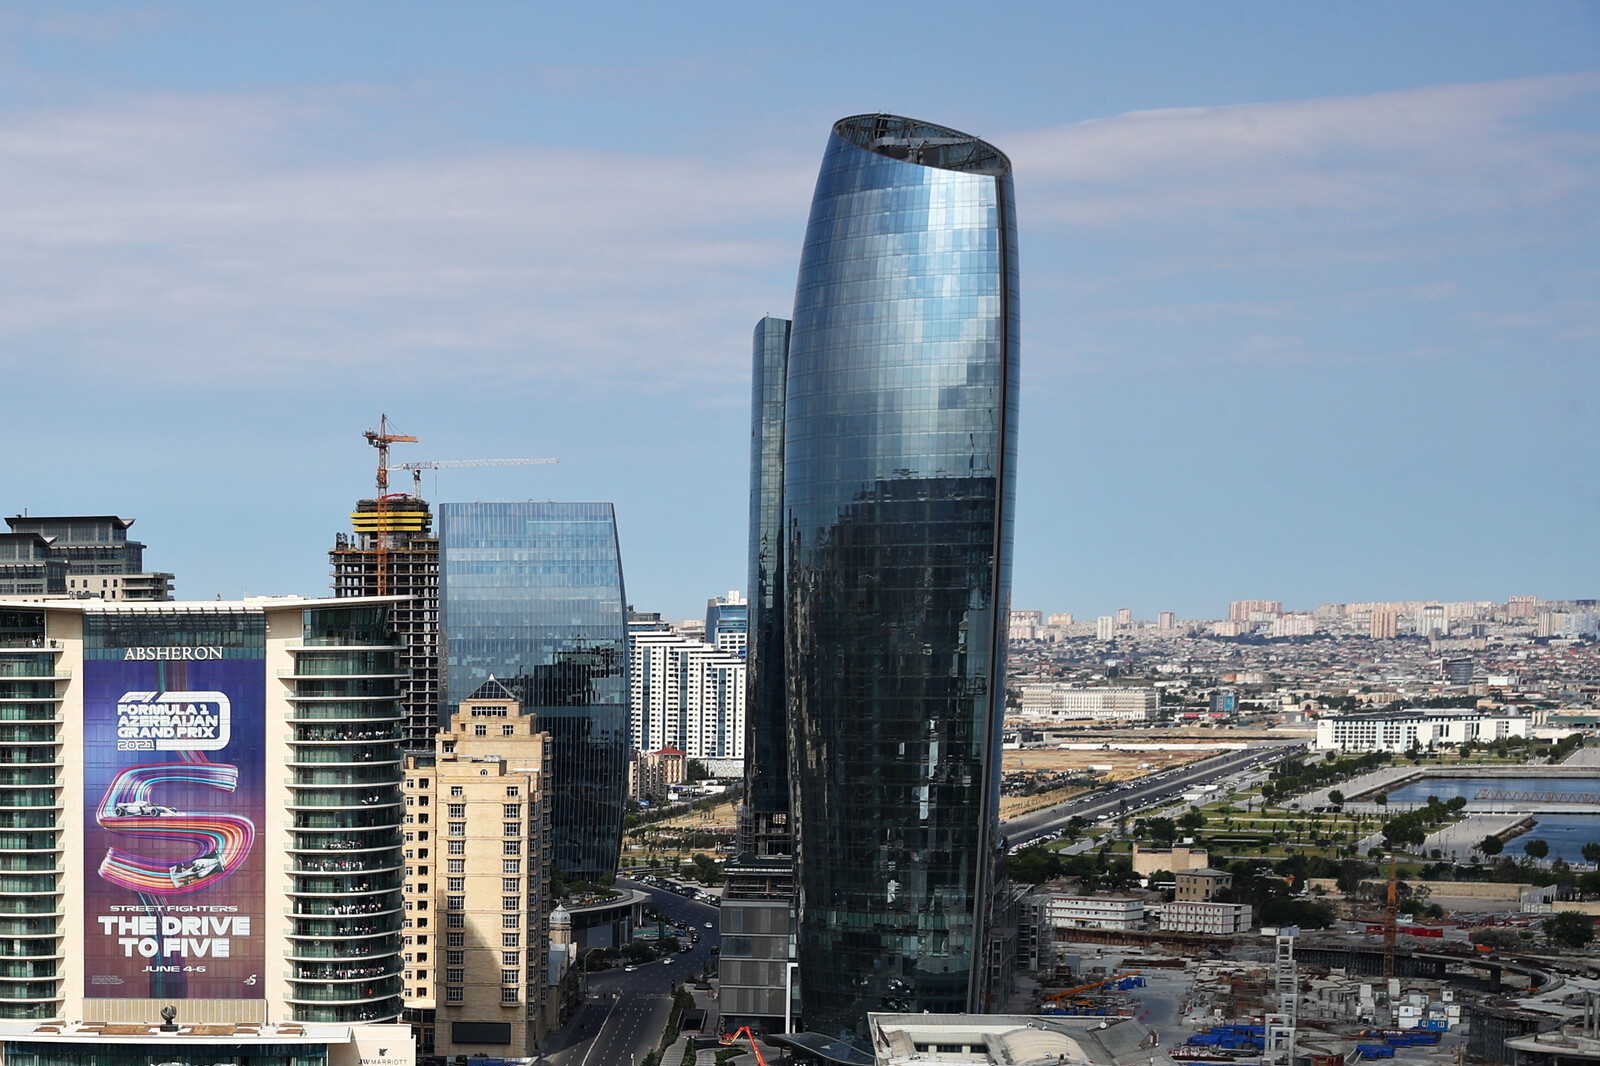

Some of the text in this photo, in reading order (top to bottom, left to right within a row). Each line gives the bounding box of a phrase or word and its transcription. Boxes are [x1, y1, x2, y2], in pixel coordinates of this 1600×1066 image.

[124, 646, 223, 661] ABSHERON
[117, 704, 209, 715] FORMULA 1
[117, 715, 218, 727] AZERBAIJAN
[117, 727, 215, 738] GRAND PRIX
[118, 740, 155, 750] 2021
[97, 916, 250, 936] THE DRIVE
[118, 938, 230, 958] TO FIVE
[141, 965, 206, 973] JUNE 4-6
